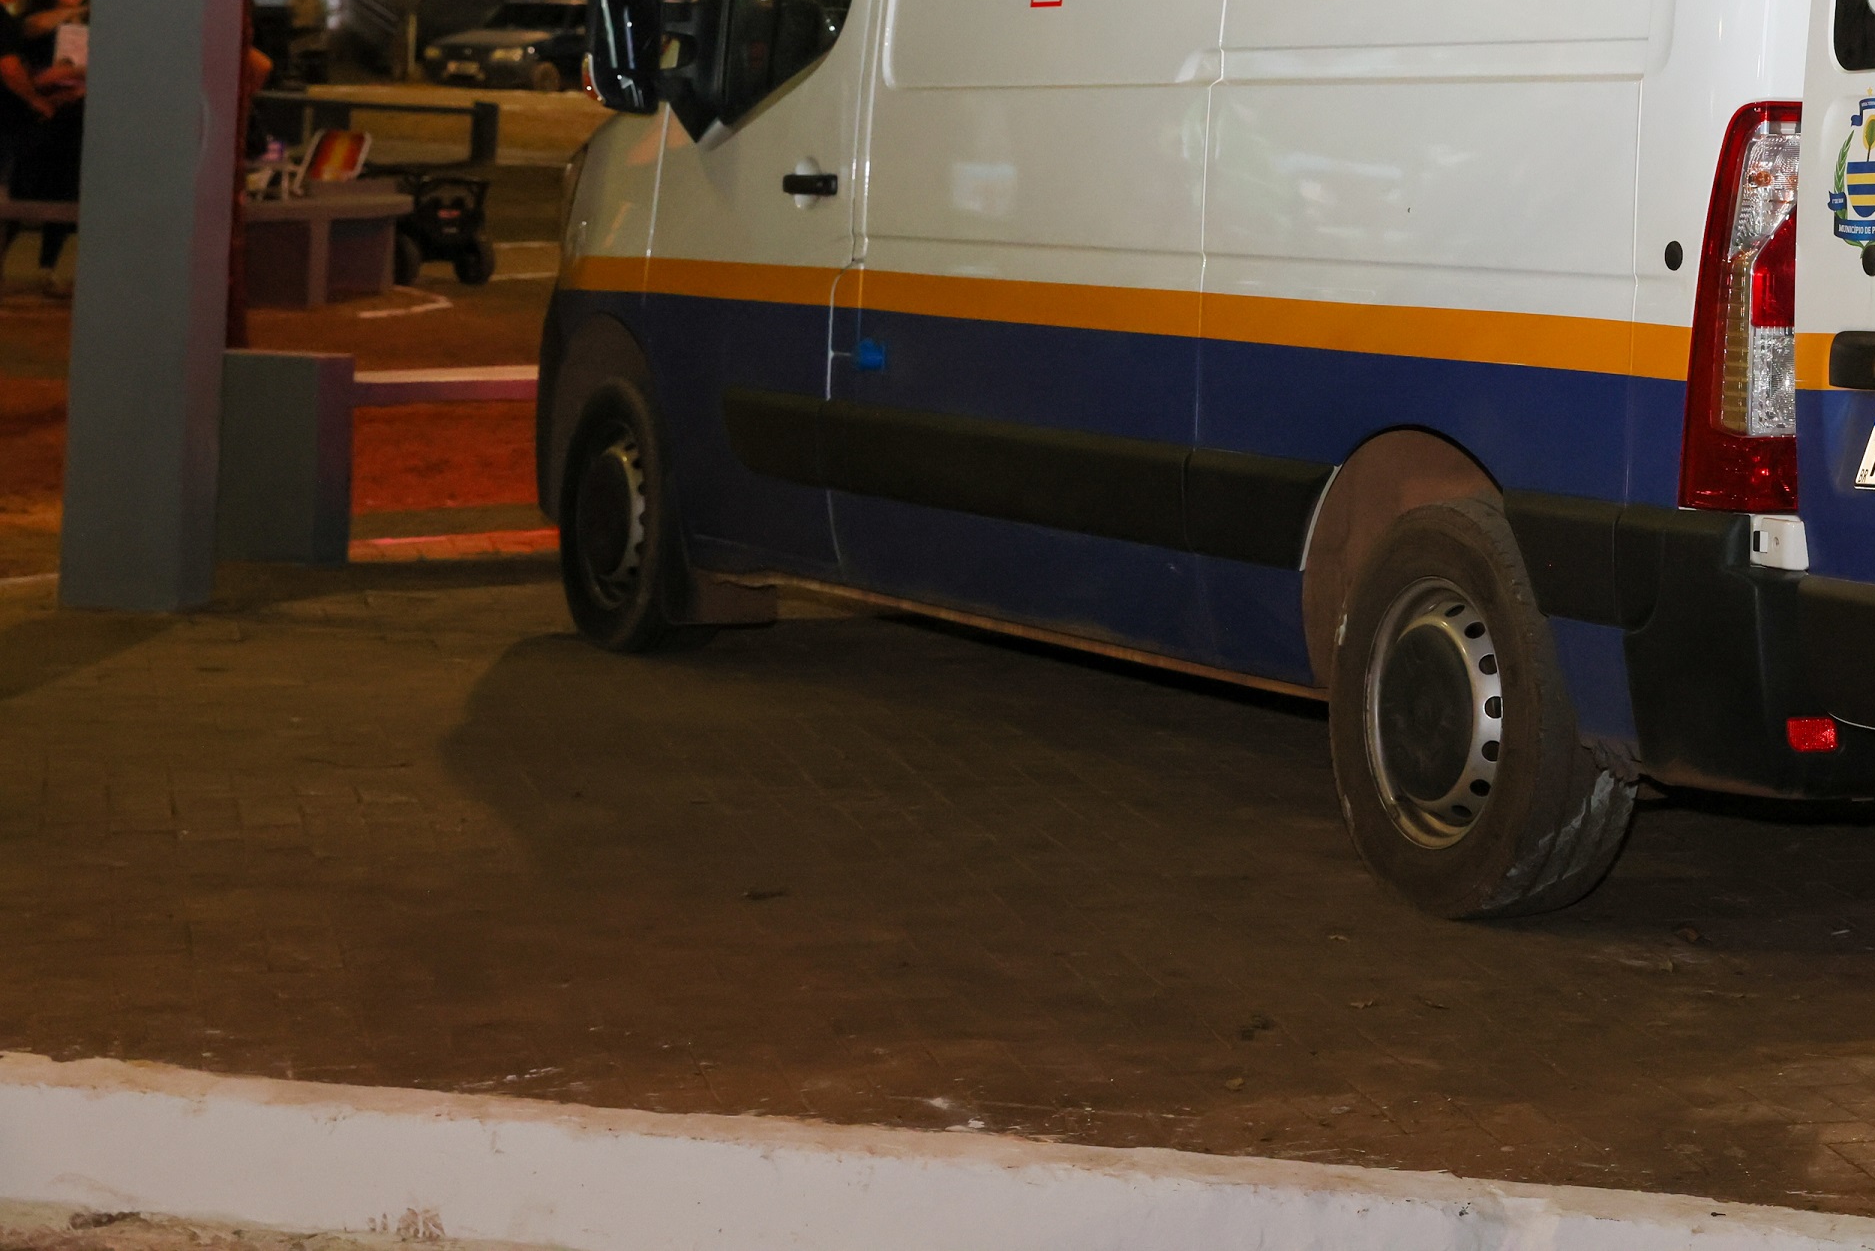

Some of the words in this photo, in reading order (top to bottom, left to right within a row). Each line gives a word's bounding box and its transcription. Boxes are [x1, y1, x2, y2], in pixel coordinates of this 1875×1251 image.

[1838, 223, 1864, 234] MUNICÍPIO
[1864, 226, 1872, 234] DE
[1857, 468, 1869, 483] BR
